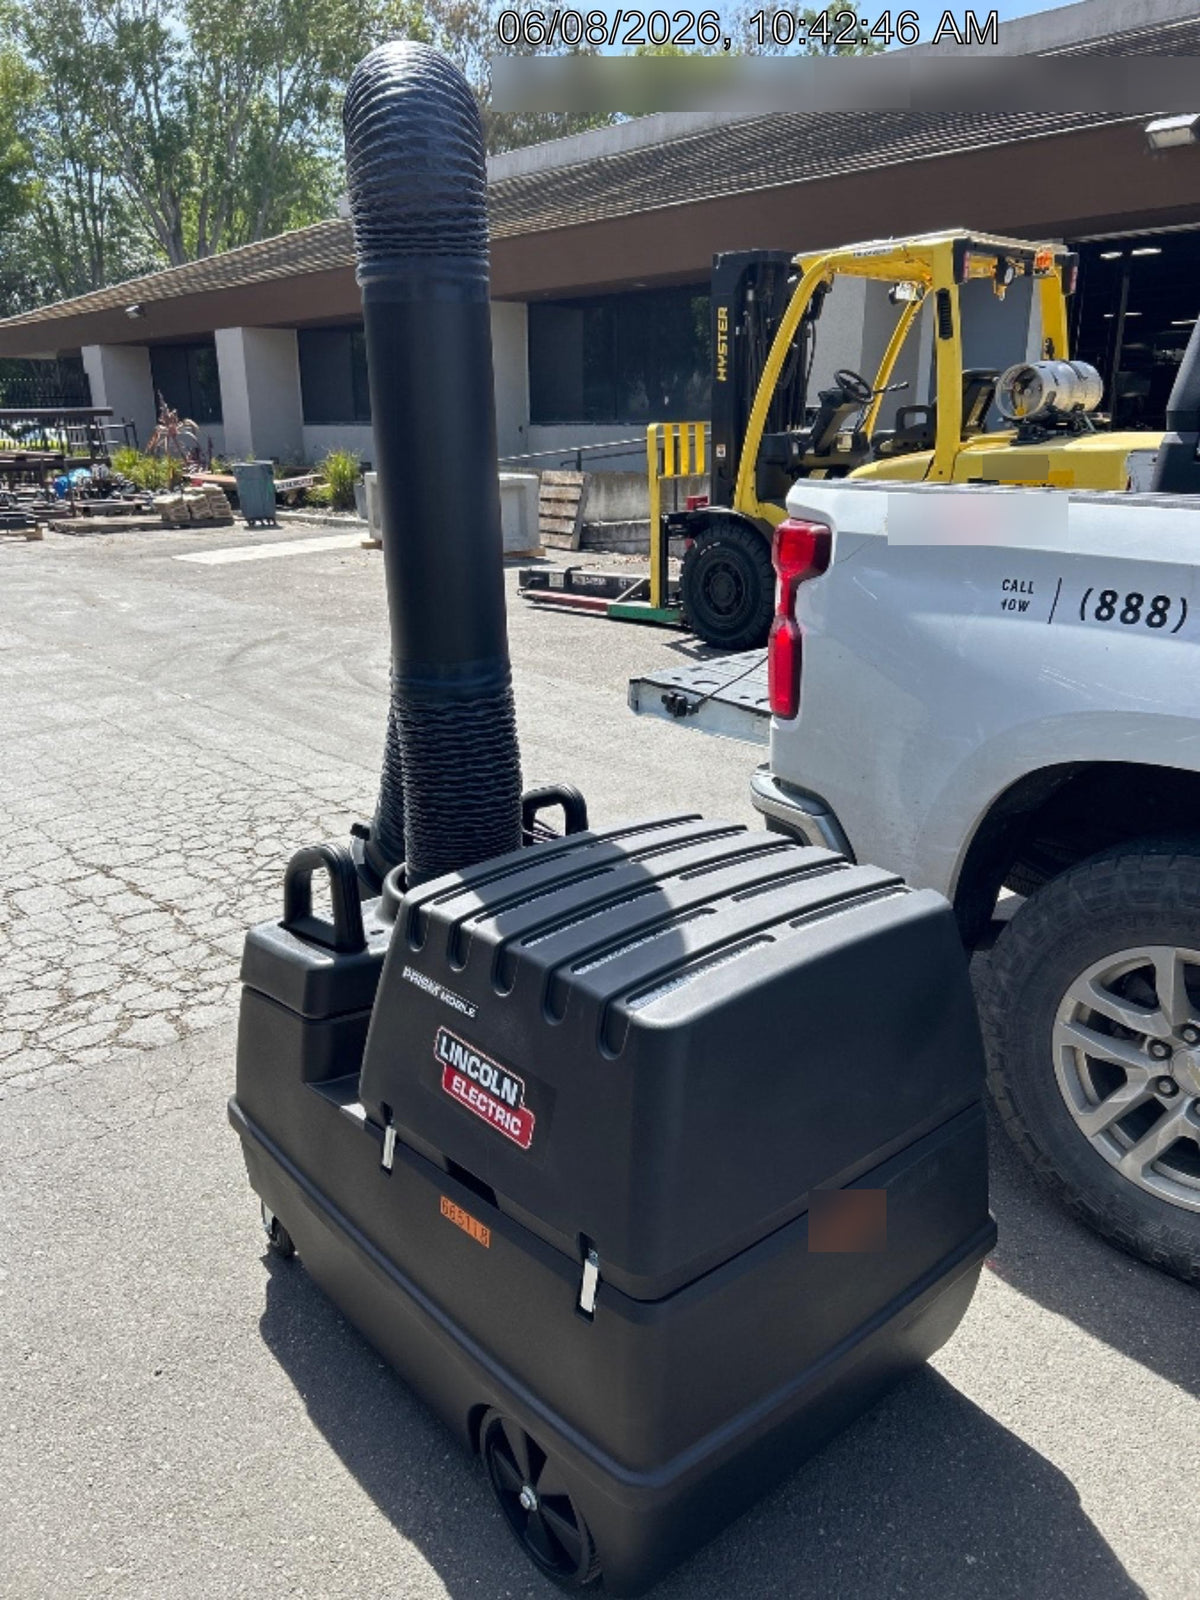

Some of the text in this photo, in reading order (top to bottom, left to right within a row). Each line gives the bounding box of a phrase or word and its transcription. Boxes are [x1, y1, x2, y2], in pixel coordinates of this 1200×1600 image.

[717, 306, 728, 381] HYSTER
[1002, 579, 1034, 594] CALL
[1080, 587, 1188, 633] (888)
[440, 1035, 518, 1107] LINCOLN
[452, 1075, 521, 1135] ELECTRIC
